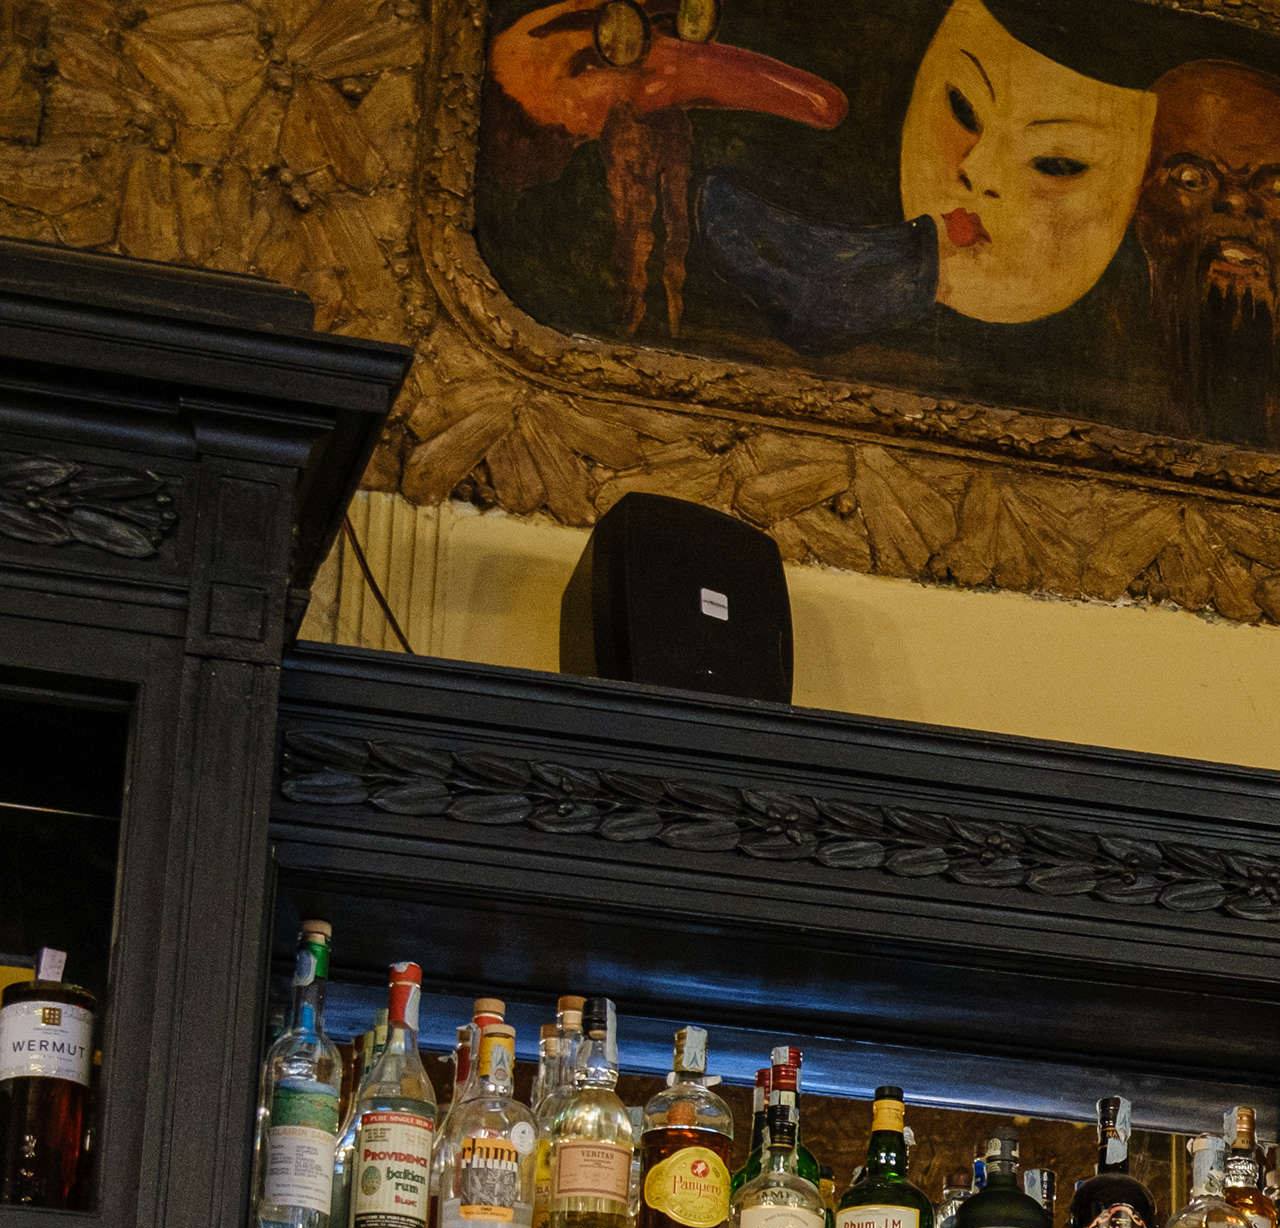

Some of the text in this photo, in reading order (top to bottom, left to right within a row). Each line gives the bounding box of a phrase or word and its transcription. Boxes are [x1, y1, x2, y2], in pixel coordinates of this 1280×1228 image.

[12, 1039, 87, 1059] WERMUT
[363, 1149, 428, 1168] PROVIDENCE
[581, 1150, 614, 1160] VERITAS
[395, 1181, 419, 1195] rum
[673, 1174, 722, 1197] Pampero
